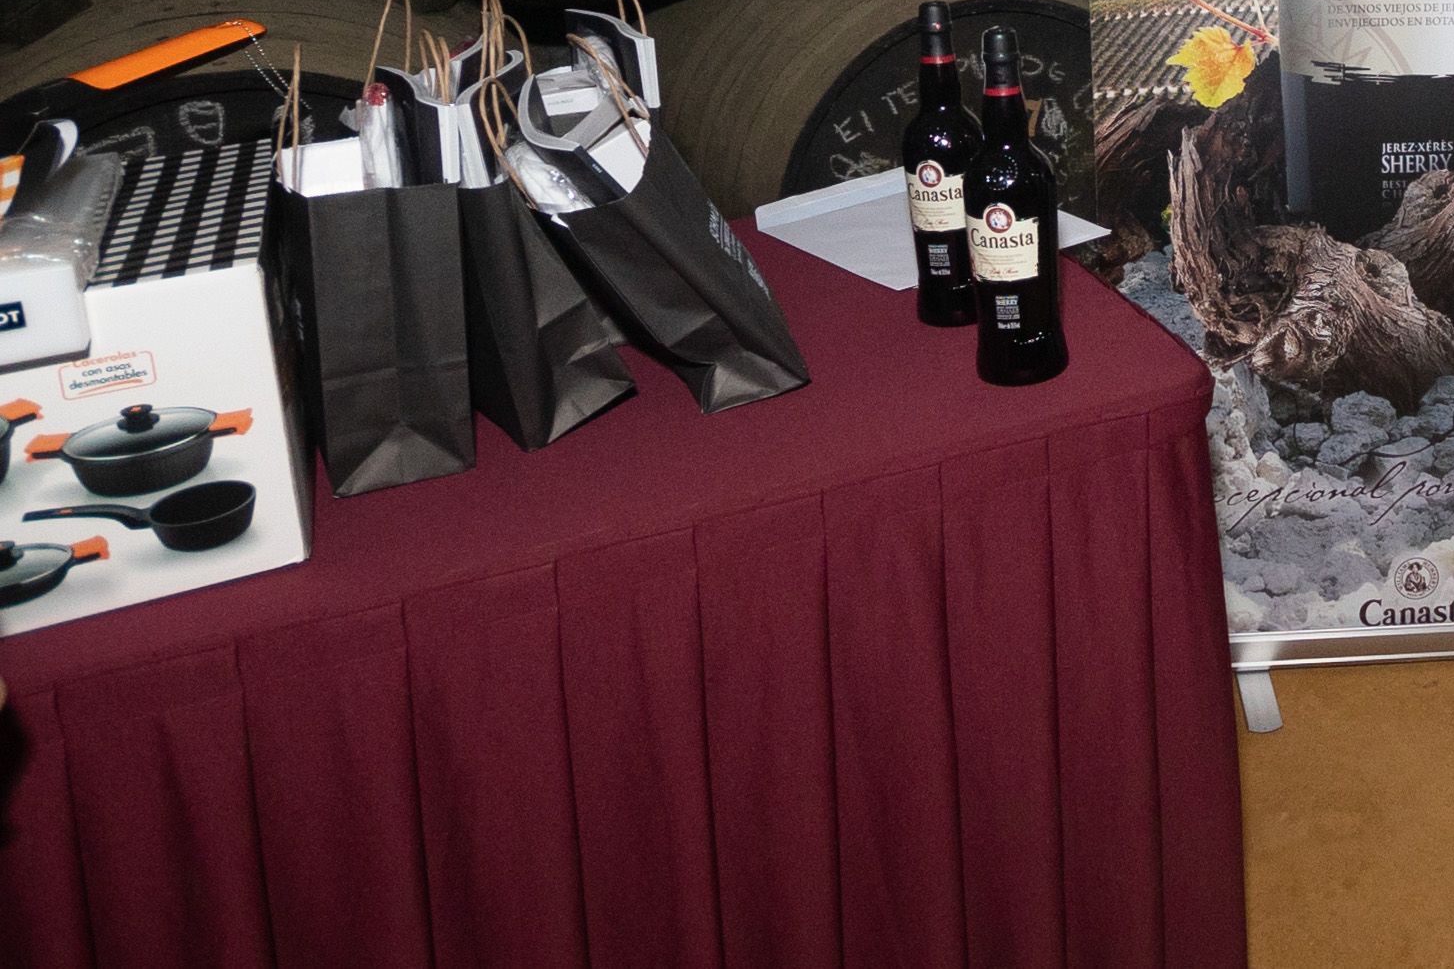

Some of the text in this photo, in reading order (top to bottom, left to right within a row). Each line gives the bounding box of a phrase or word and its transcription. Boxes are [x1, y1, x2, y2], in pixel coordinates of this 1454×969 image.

[1328, 4, 1344, 15] DE
[1345, 3, 1382, 15] VINOS
[1383, 2, 1422, 15] VIEJOS
[1424, 2, 1440, 13] DE
[1328, 16, 1405, 29] ENVEJECIDOS
[1407, 16, 1423, 27] EN
[1381, 153, 1453, 174] SHERRY
[908, 182, 963, 203] Canasta
[971, 227, 1034, 249] Canasta
[69, 369, 148, 390] desmontables
[81, 362, 132, 377] con asas
